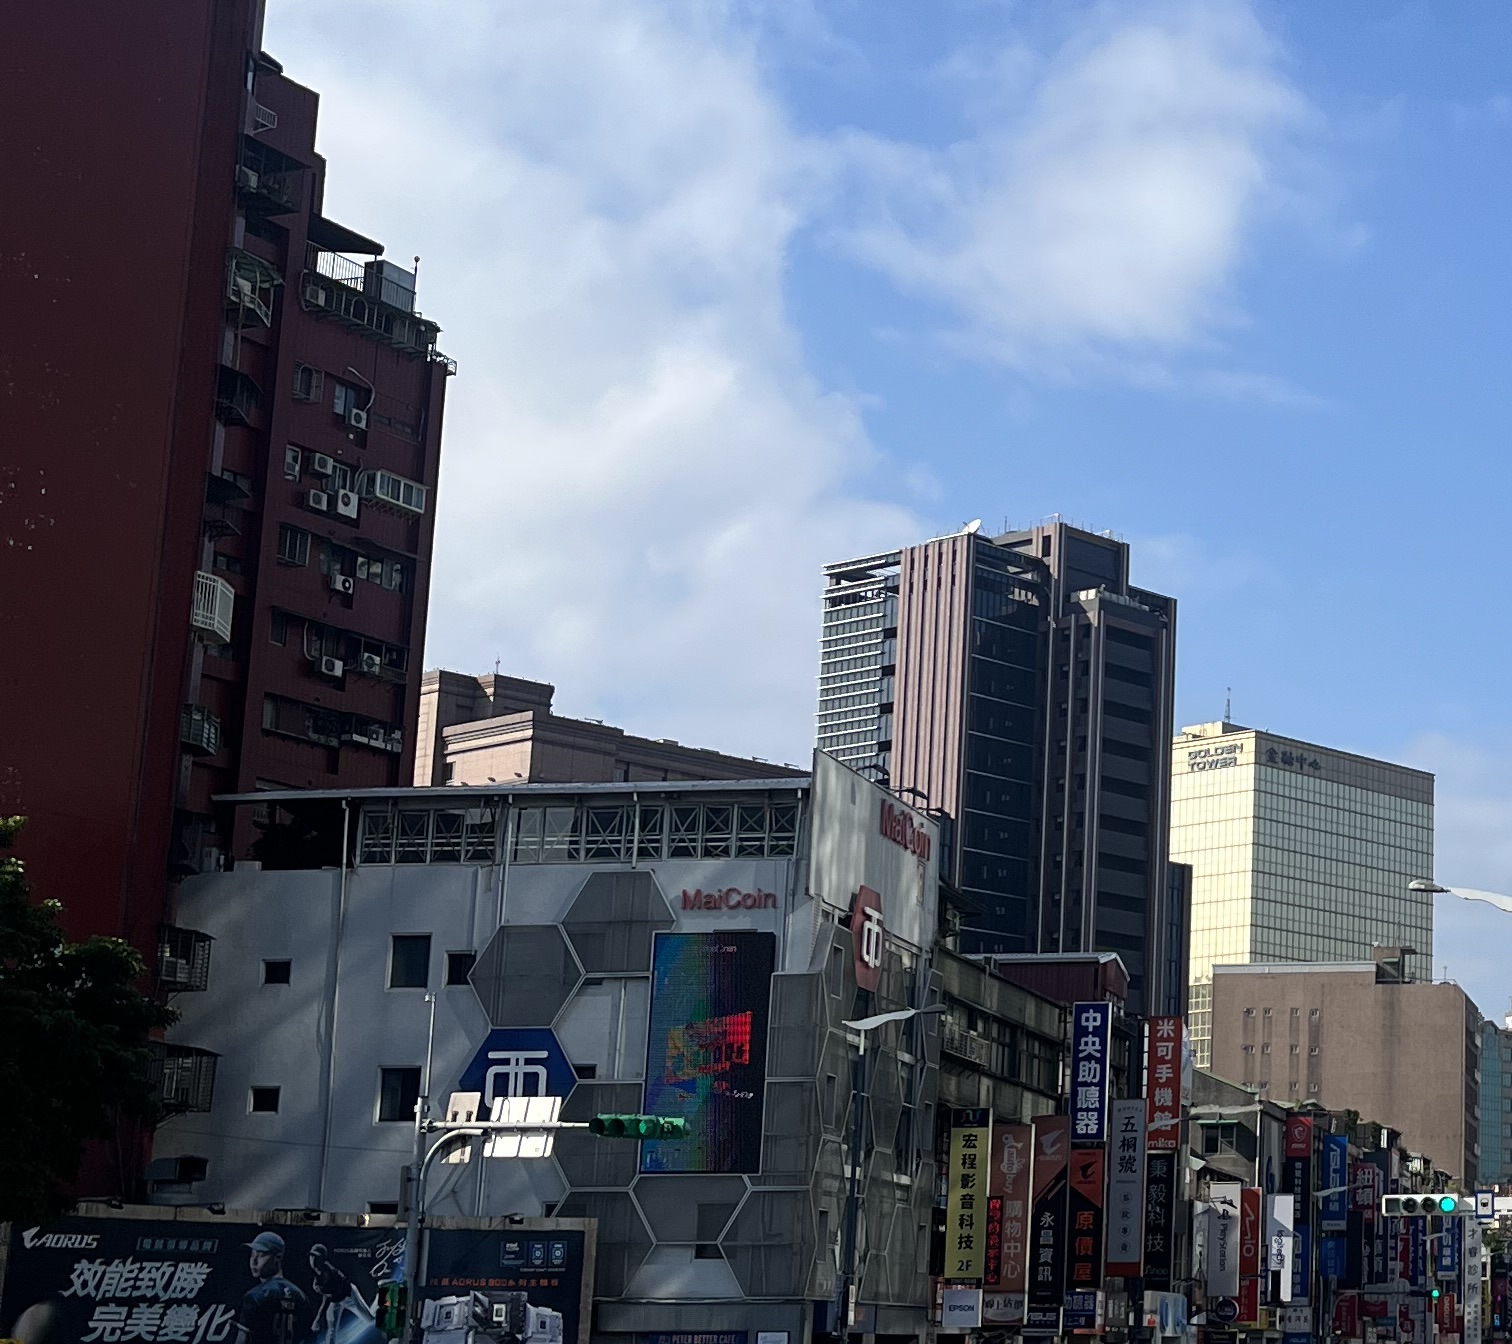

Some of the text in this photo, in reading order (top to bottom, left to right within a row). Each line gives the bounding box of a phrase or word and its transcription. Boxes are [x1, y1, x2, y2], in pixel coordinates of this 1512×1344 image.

[1188, 742, 1244, 761] GOLDEN
[1188, 756, 1238, 772] TOWER
[880, 798, 931, 862] MaiCoin
[681, 886, 777, 911] MaiCoin
[1076, 1009, 1102, 1135] 中央助聽器
[1153, 1019, 1175, 1131] 米可手機館
[1118, 1116, 1139, 1174] 五桐號
[1148, 1137, 1176, 1149] miko
[957, 1133, 978, 1250] 宏程影音科技
[38, 1234, 101, 1249] AORUS
[1003, 1200, 1023, 1279] 購物中心
[1038, 1212, 1055, 1282] 永昌資訊
[1073, 1211, 1095, 1280] 原價屋
[1219, 1223, 1229, 1272] PlayStation
[58, 1256, 213, 1302] 效能致勝
[451, 1278, 486, 1287] AORUS
[957, 1260, 973, 1272] 2F
[948, 1304, 975, 1312] EPSON
[1027, 1312, 1057, 1321] ASUS
[671, 1334, 737, 1344] PETER BETTER CAFE
